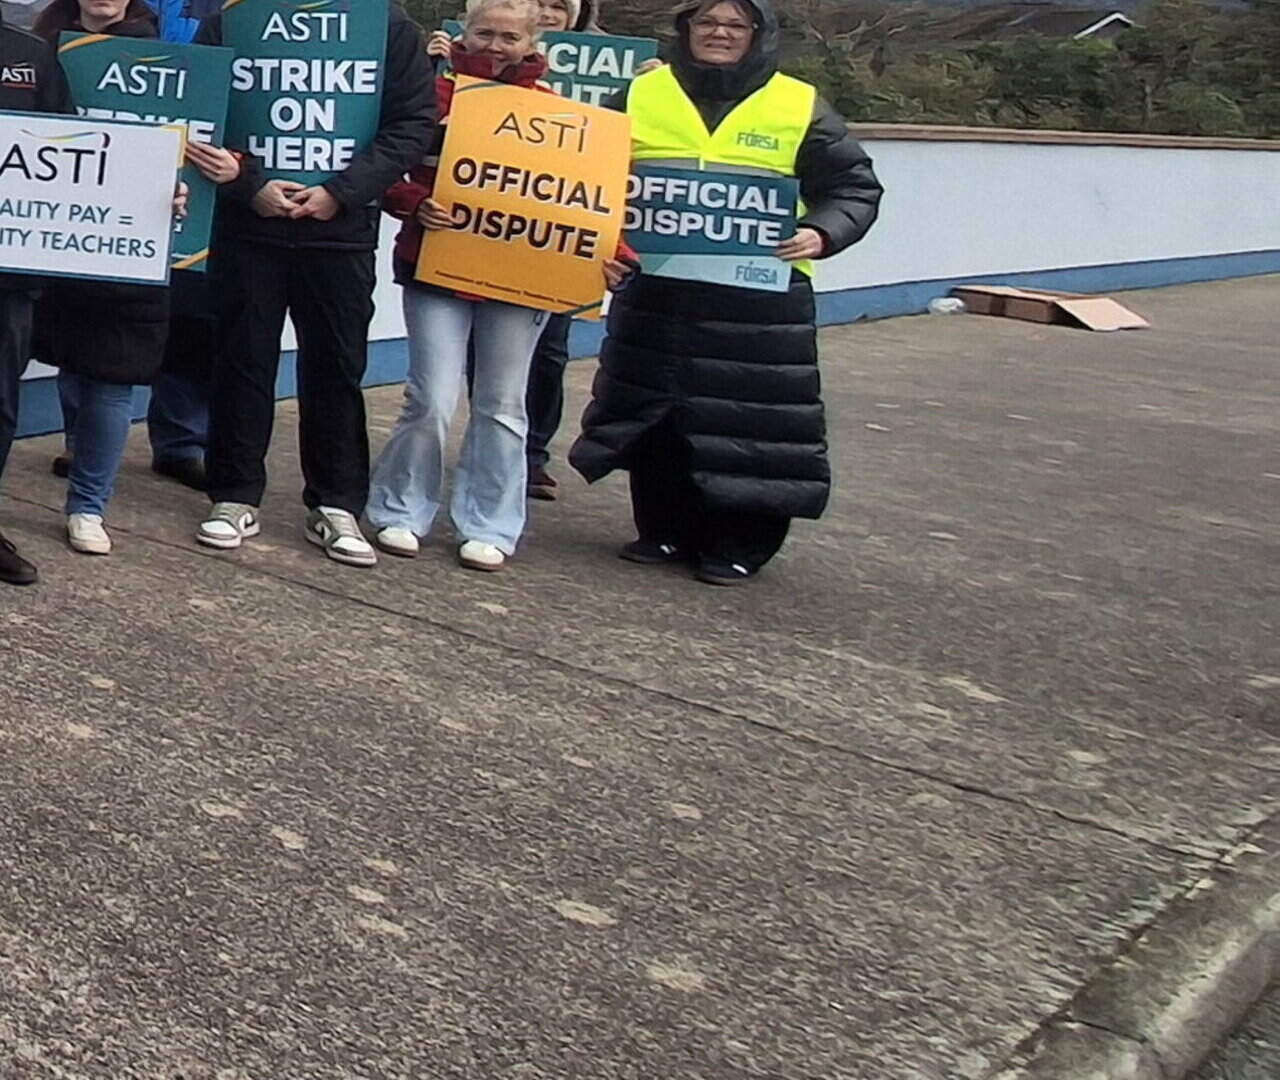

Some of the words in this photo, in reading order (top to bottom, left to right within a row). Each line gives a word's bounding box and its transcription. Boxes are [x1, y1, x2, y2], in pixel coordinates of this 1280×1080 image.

[261, 12, 347, 42] ASTI
[1, 67, 36, 84] ASTI
[97, 62, 187, 99] ASTI
[231, 58, 378, 94] STRIKE
[270, 97, 335, 132] ON
[249, 135, 355, 171] HERE
[452, 157, 611, 214] OFFICIAL
[624, 175, 790, 216] OFFICIAL
[68, 204, 112, 226] PAY
[450, 202, 599, 259] DISPUTE
[40, 230, 157, 258] TEACHERS
